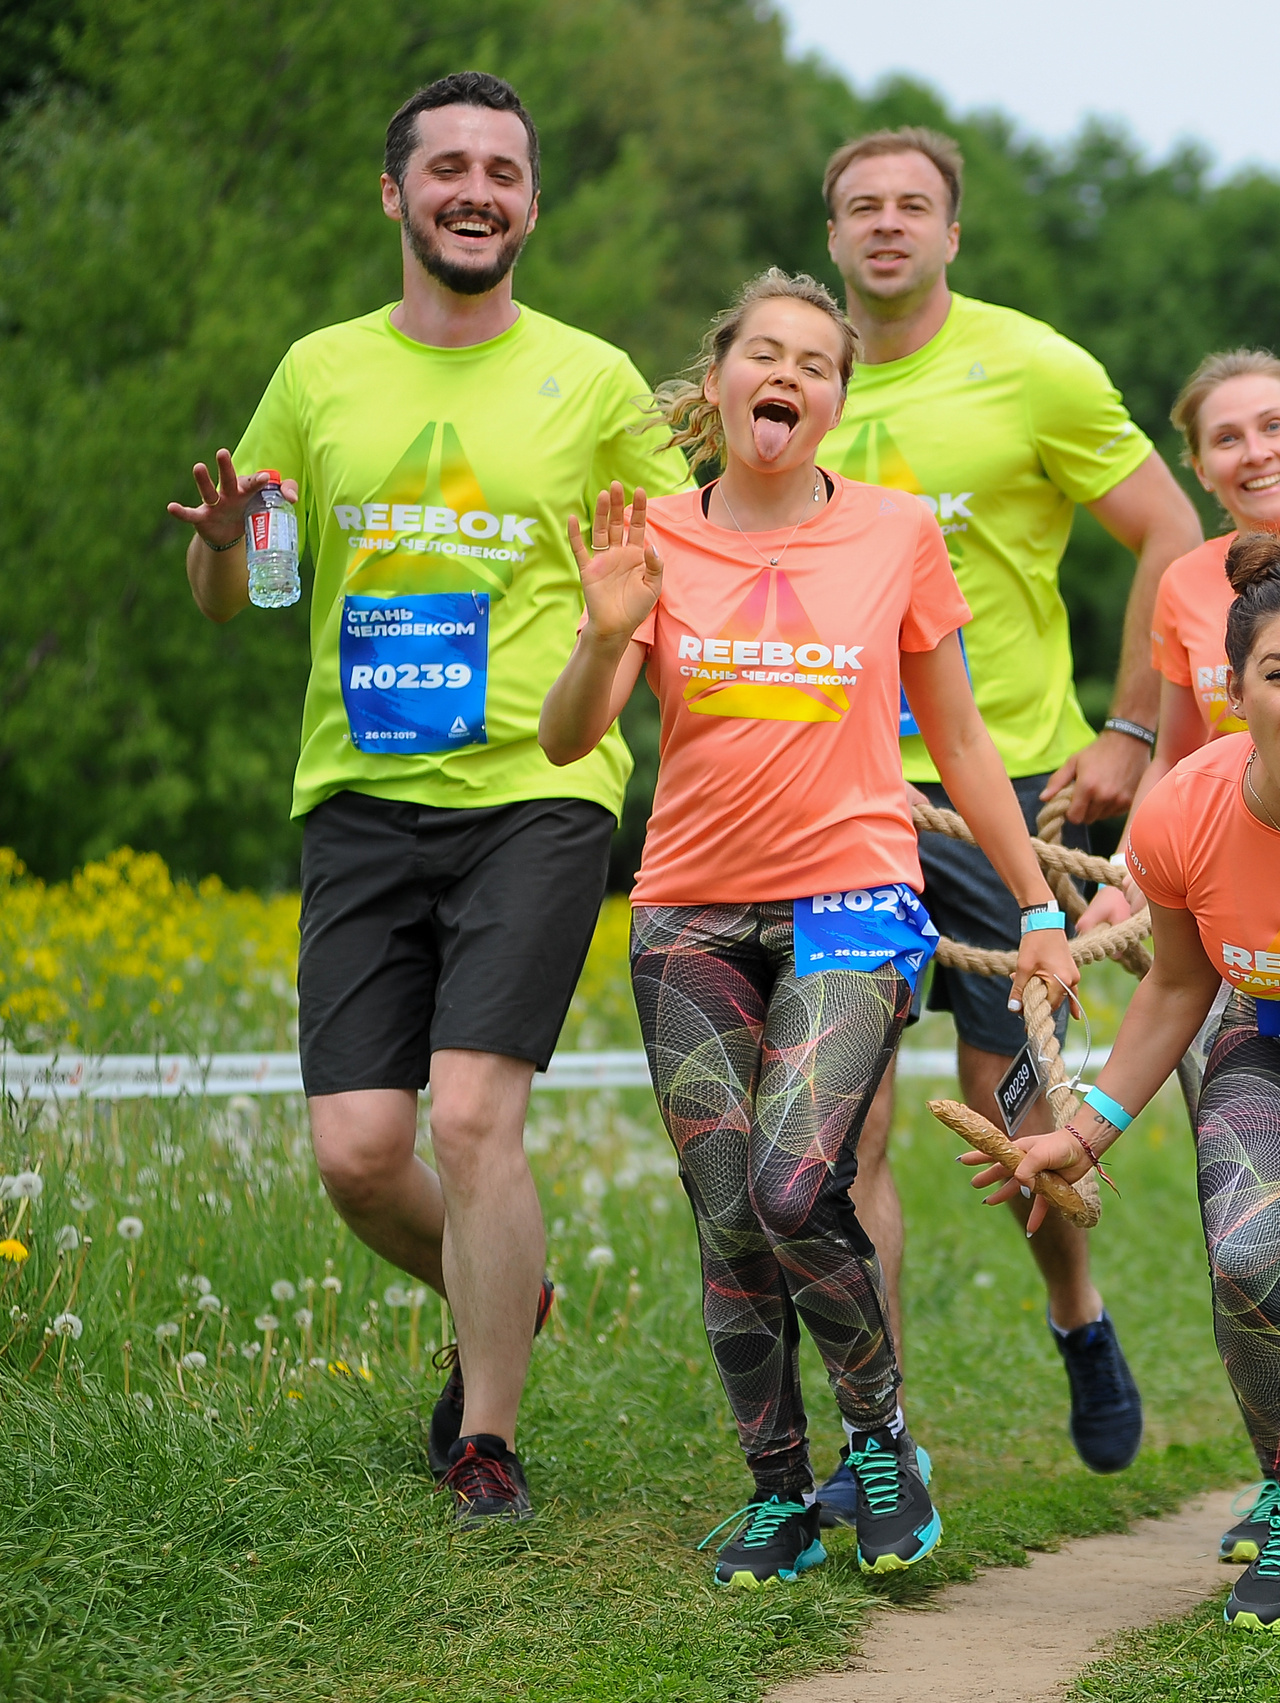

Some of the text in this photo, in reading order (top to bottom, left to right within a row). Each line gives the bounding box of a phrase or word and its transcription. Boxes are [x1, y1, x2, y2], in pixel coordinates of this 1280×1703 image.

[256, 515, 267, 542] Vittel
[333, 503, 538, 546] REEBOK
[348, 536, 525, 563] СТАНЬ ЧЕЛОВЕКОМ
[347, 608, 414, 623] СТАНЬ
[346, 621, 476, 638] ЧЕЛОВЕКОМ
[677, 634, 865, 670] REEBOK
[349, 662, 473, 690] R0239
[679, 665, 857, 686] СТАНЬ ЧЕЛОВЕКОМ
[1002, 1063, 1030, 1109] R0239
